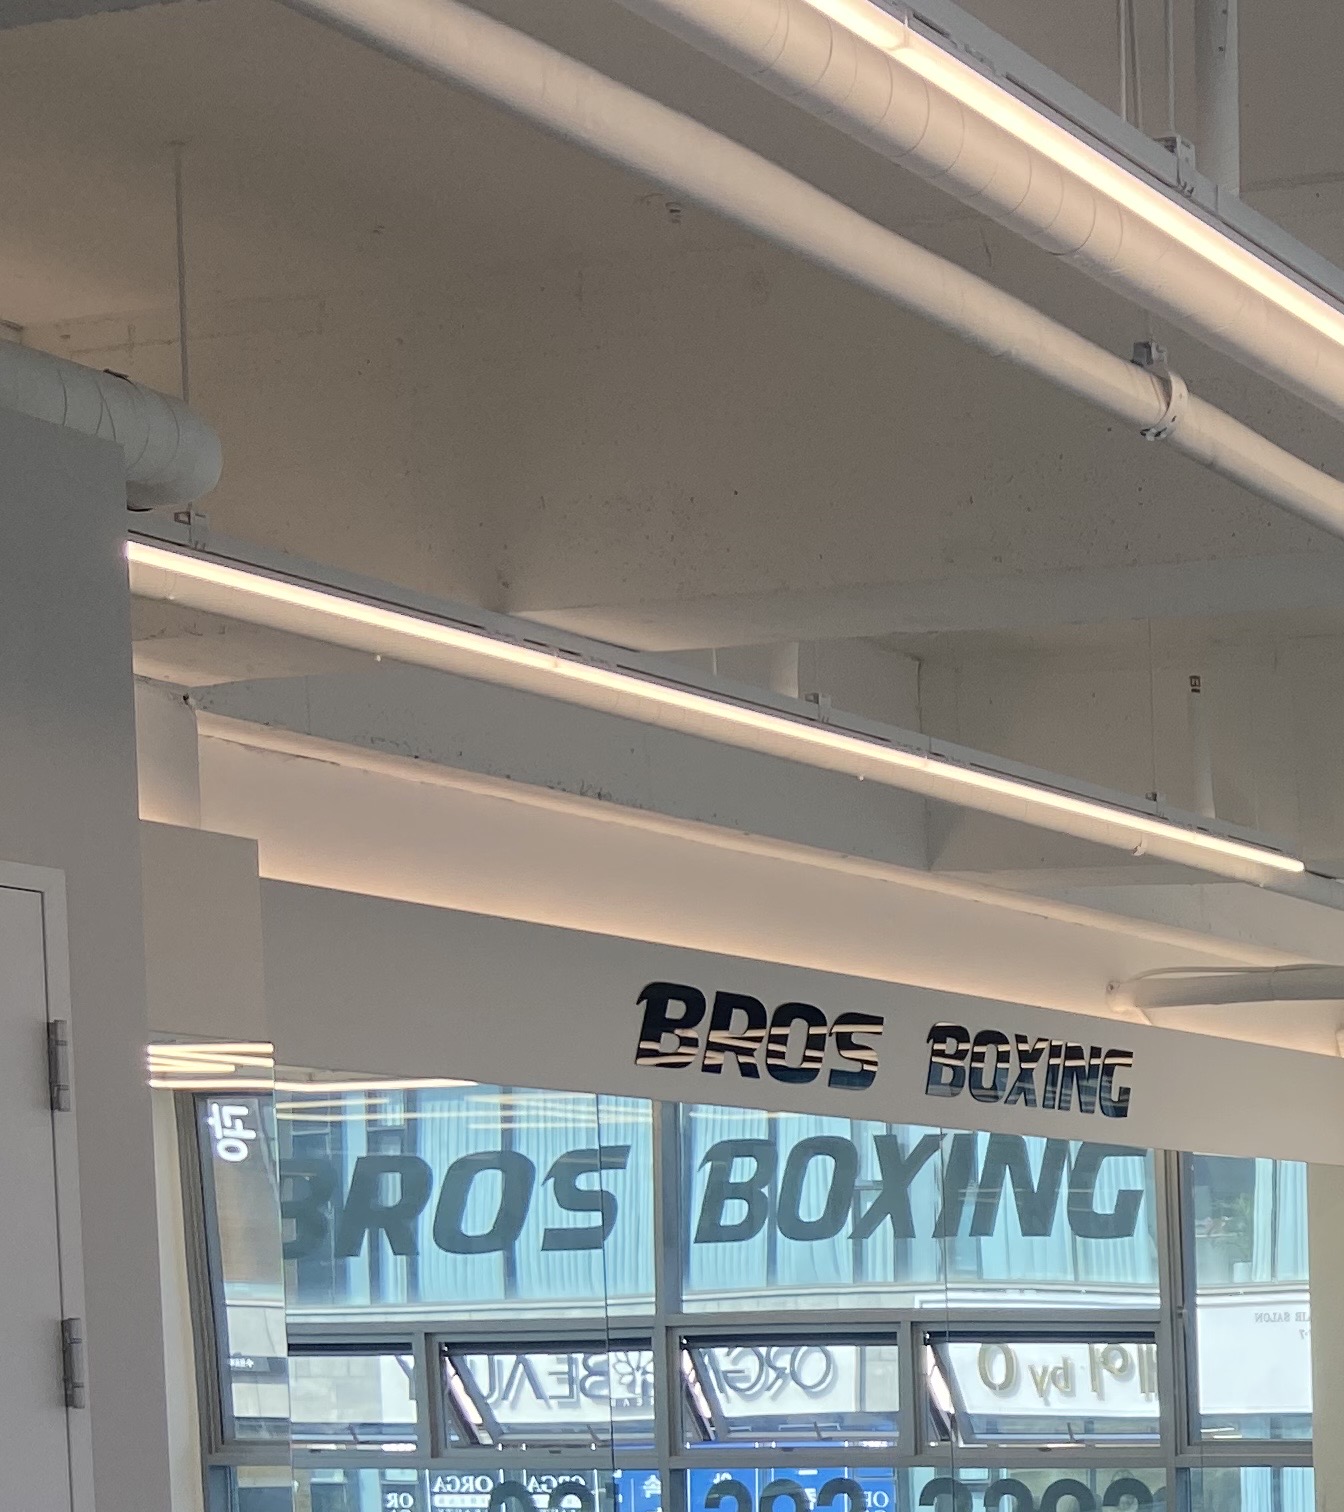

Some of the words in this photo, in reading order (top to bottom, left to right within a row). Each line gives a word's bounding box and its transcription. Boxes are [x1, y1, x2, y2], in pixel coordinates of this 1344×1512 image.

[635, 981, 885, 1091] BROS
[924, 1021, 1134, 1118] BOXING
[694, 1131, 1148, 1243] BOXING
